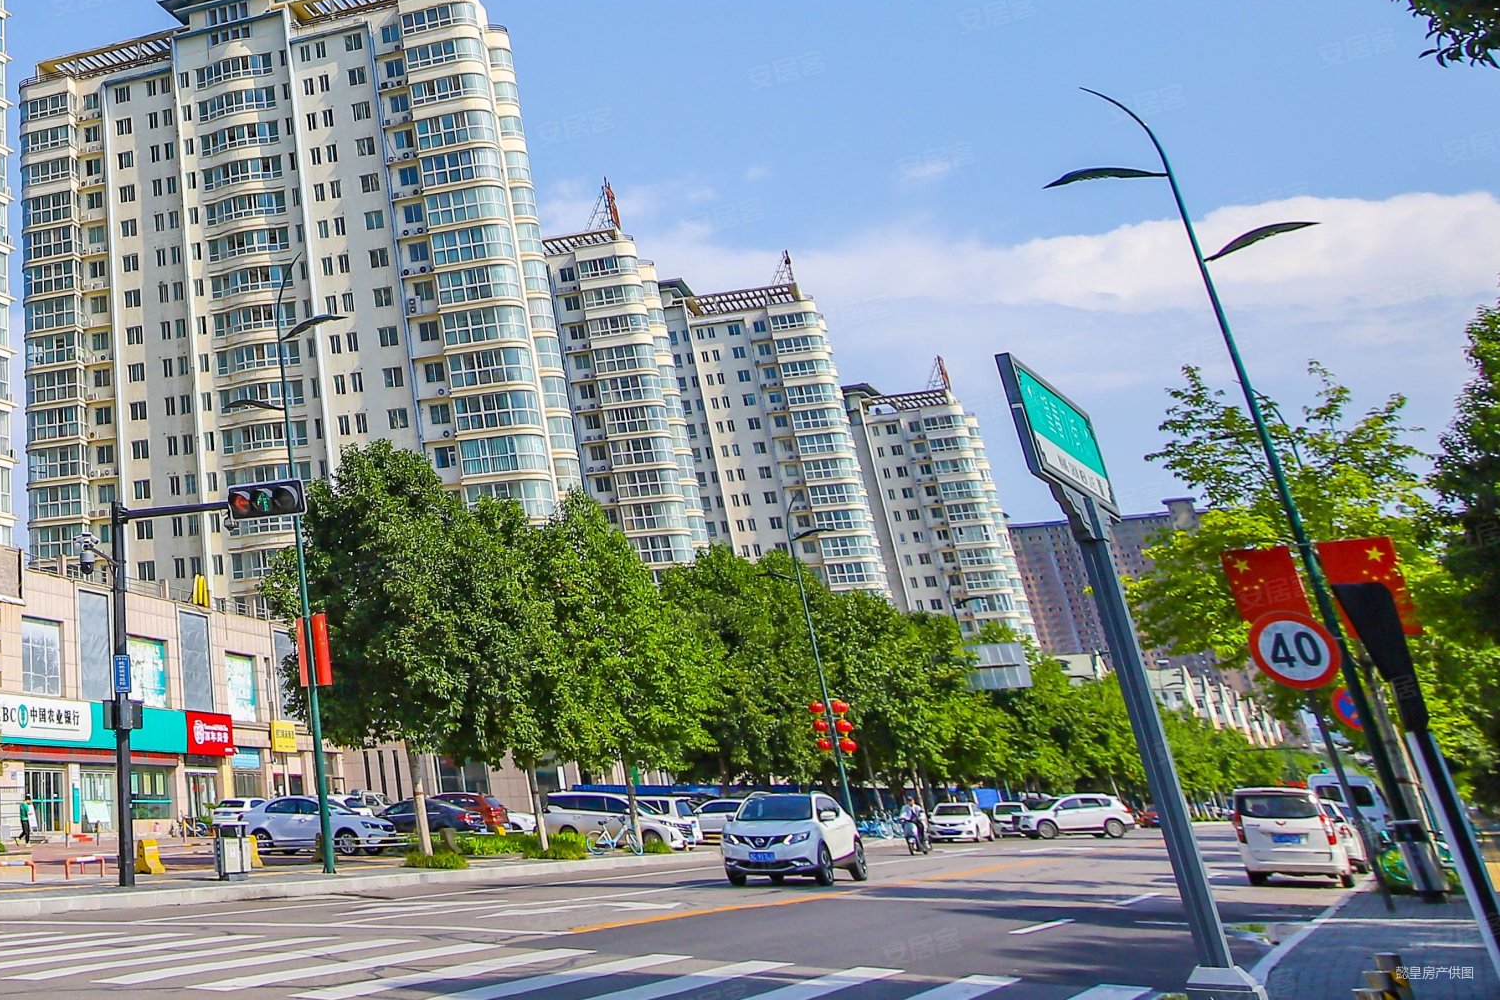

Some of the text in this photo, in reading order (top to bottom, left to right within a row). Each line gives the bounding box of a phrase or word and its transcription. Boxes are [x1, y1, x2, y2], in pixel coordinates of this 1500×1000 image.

[1271, 631, 1321, 668] 40
[30, 706, 80, 726] 中国农业银行
